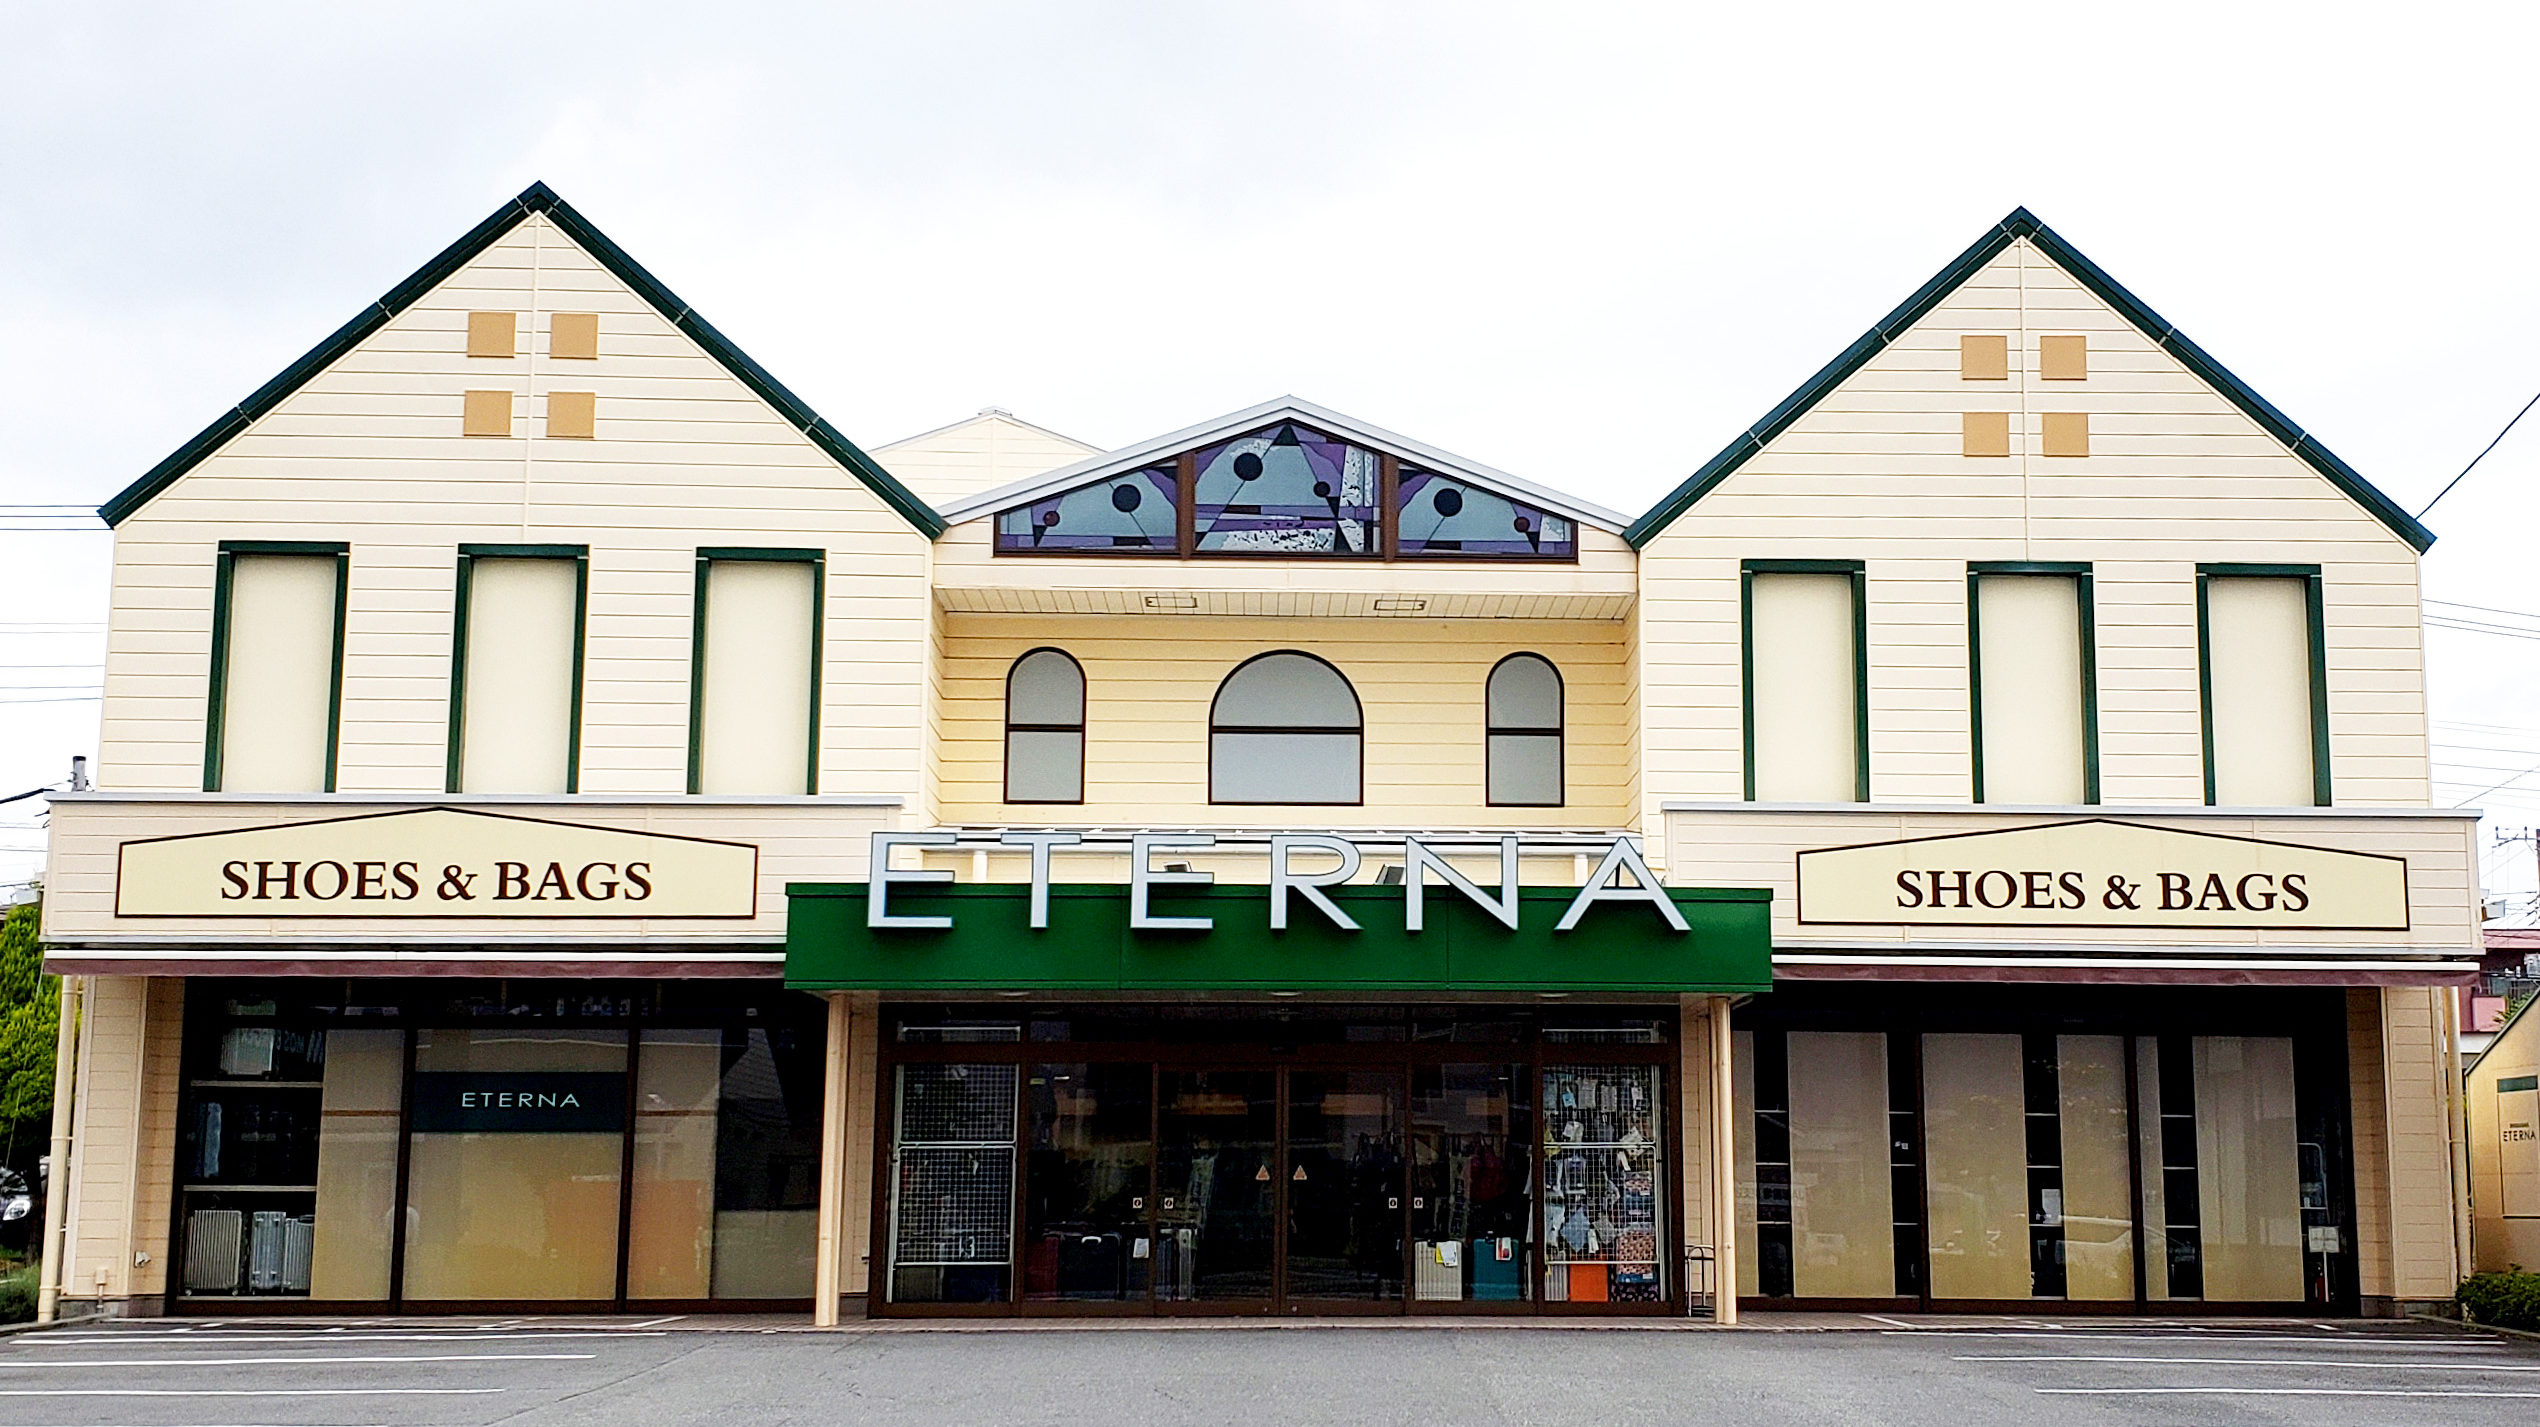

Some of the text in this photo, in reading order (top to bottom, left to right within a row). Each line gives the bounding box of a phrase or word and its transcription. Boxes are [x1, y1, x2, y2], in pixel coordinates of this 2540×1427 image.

[221, 860, 652, 902] SHOES & BAGS
[867, 831, 1692, 931] ETERNA
[1896, 870, 2309, 912] SHOES & BAGS
[461, 1092, 580, 1108] ETERNA
[2503, 1130, 2536, 1141] ETERNA
